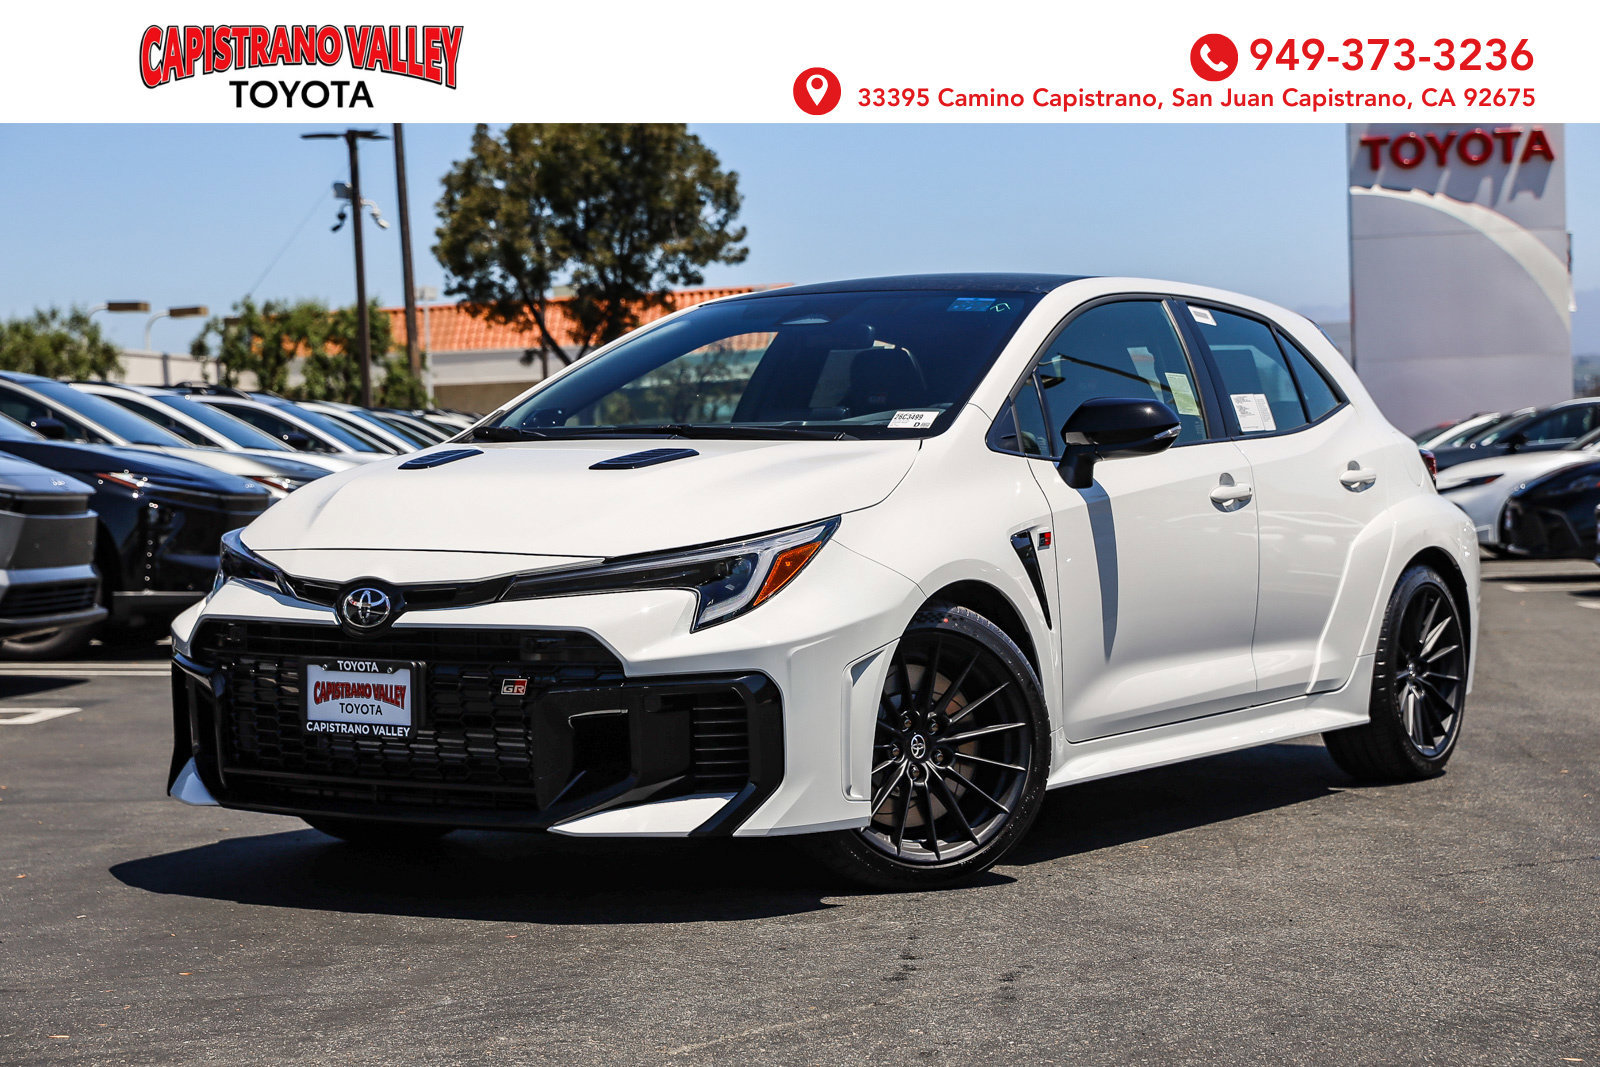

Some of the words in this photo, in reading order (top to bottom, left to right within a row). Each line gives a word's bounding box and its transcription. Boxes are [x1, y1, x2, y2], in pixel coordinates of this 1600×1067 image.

[1359, 127, 1555, 171] TOYOTA
[337, 660, 379, 672] TOYOTA
[314, 681, 372, 705] CAPISTRANO
[372, 683, 407, 710] VALLEY
[503, 684, 526, 694] GR
[339, 703, 382, 715] TOYOTA
[306, 722, 369, 735] CAPISTRANO
[372, 725, 410, 737] VALLEY
